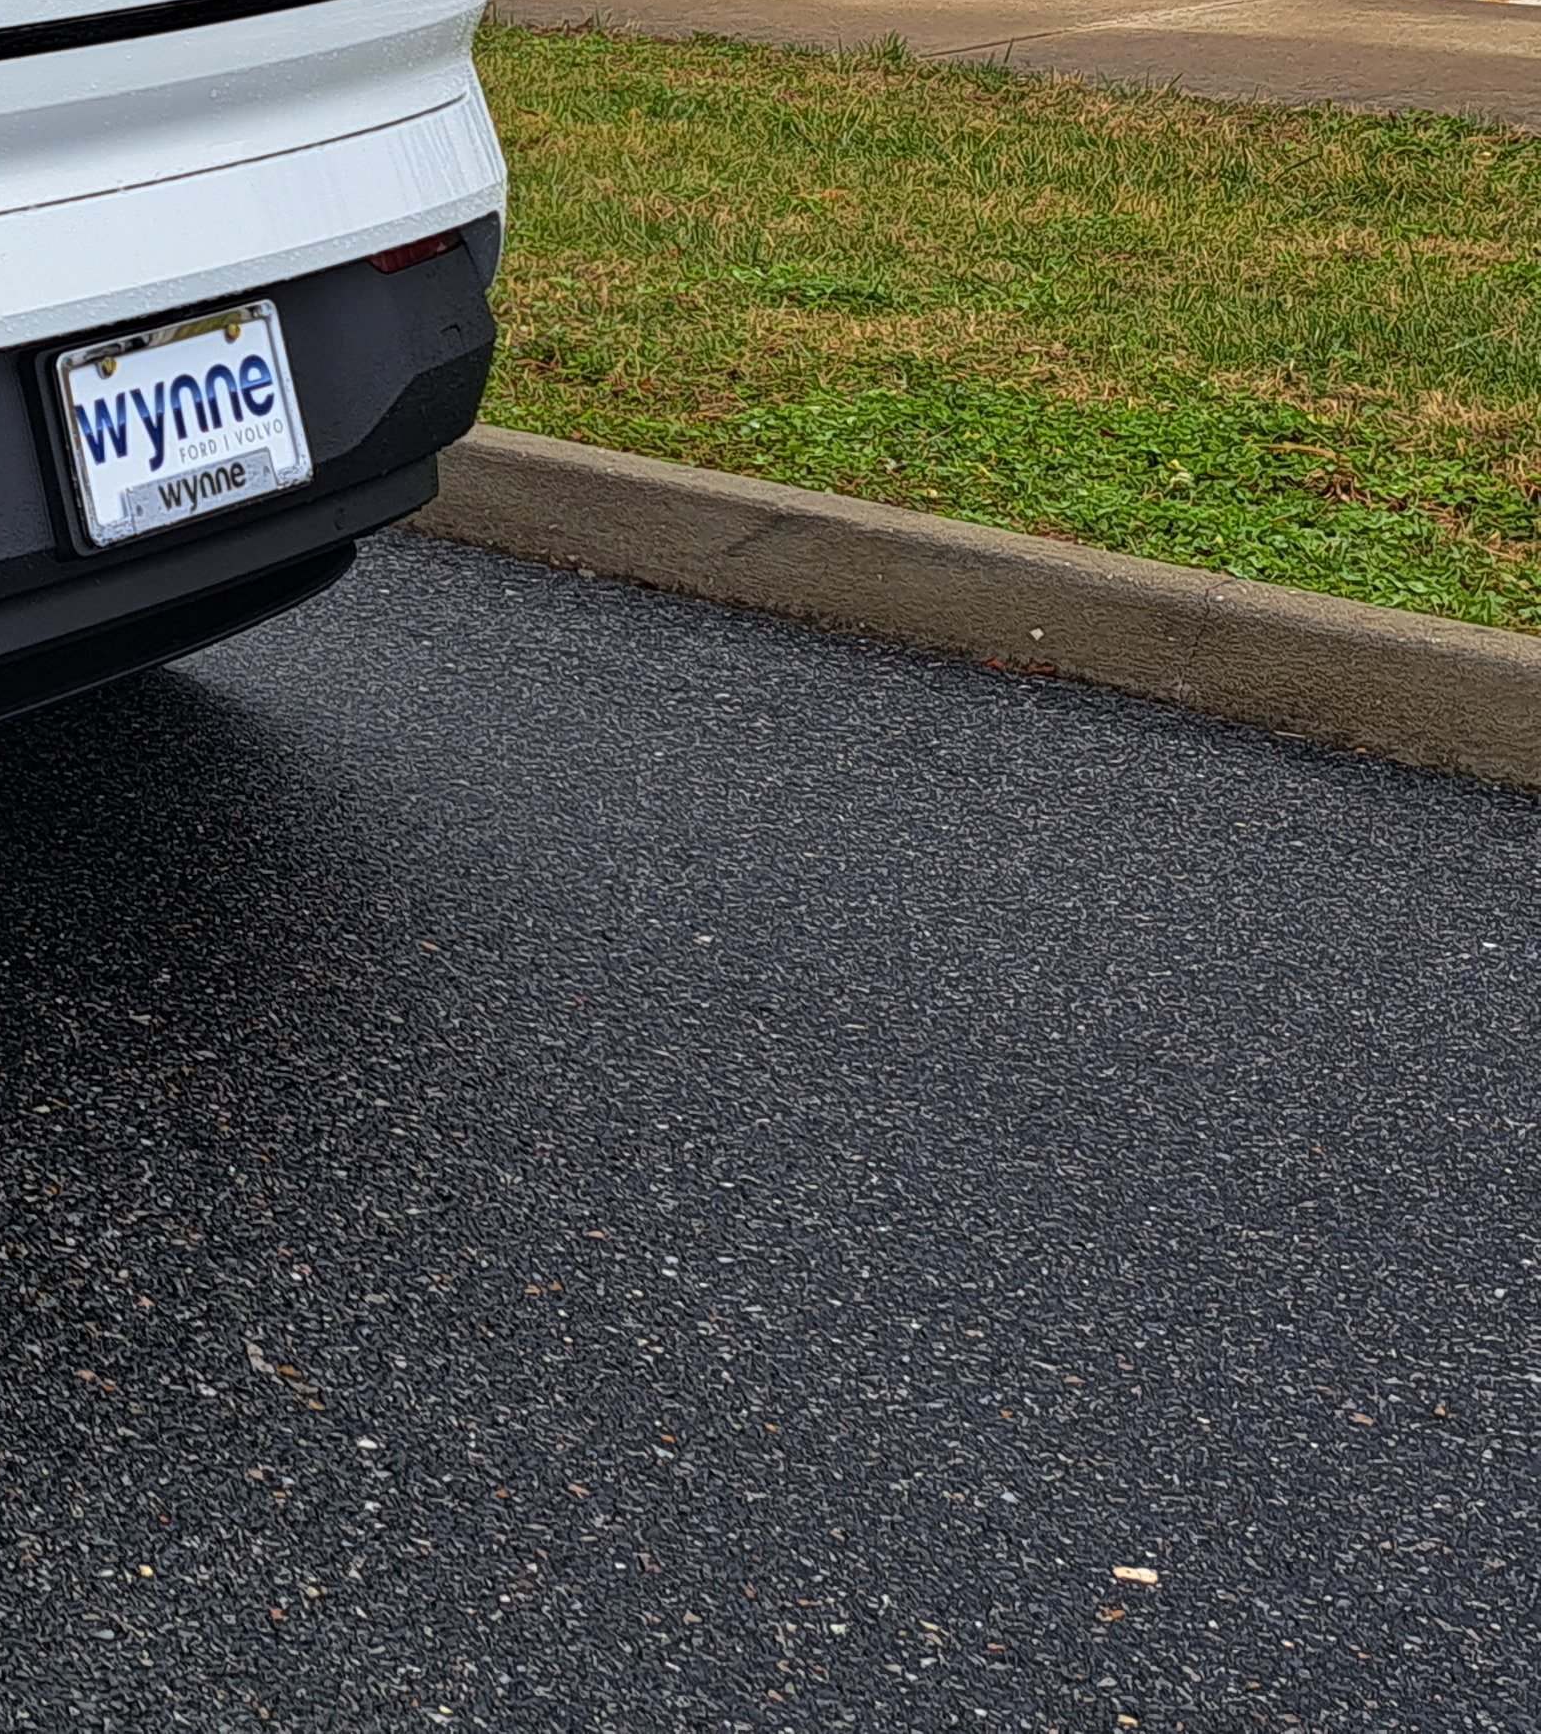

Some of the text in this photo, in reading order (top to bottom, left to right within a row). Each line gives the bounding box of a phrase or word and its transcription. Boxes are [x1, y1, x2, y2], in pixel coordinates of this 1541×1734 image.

[75, 354, 275, 472] wynne
[179, 440, 217, 463] FORD
[235, 419, 284, 444] VOLVO
[158, 462, 246, 513] wynne
